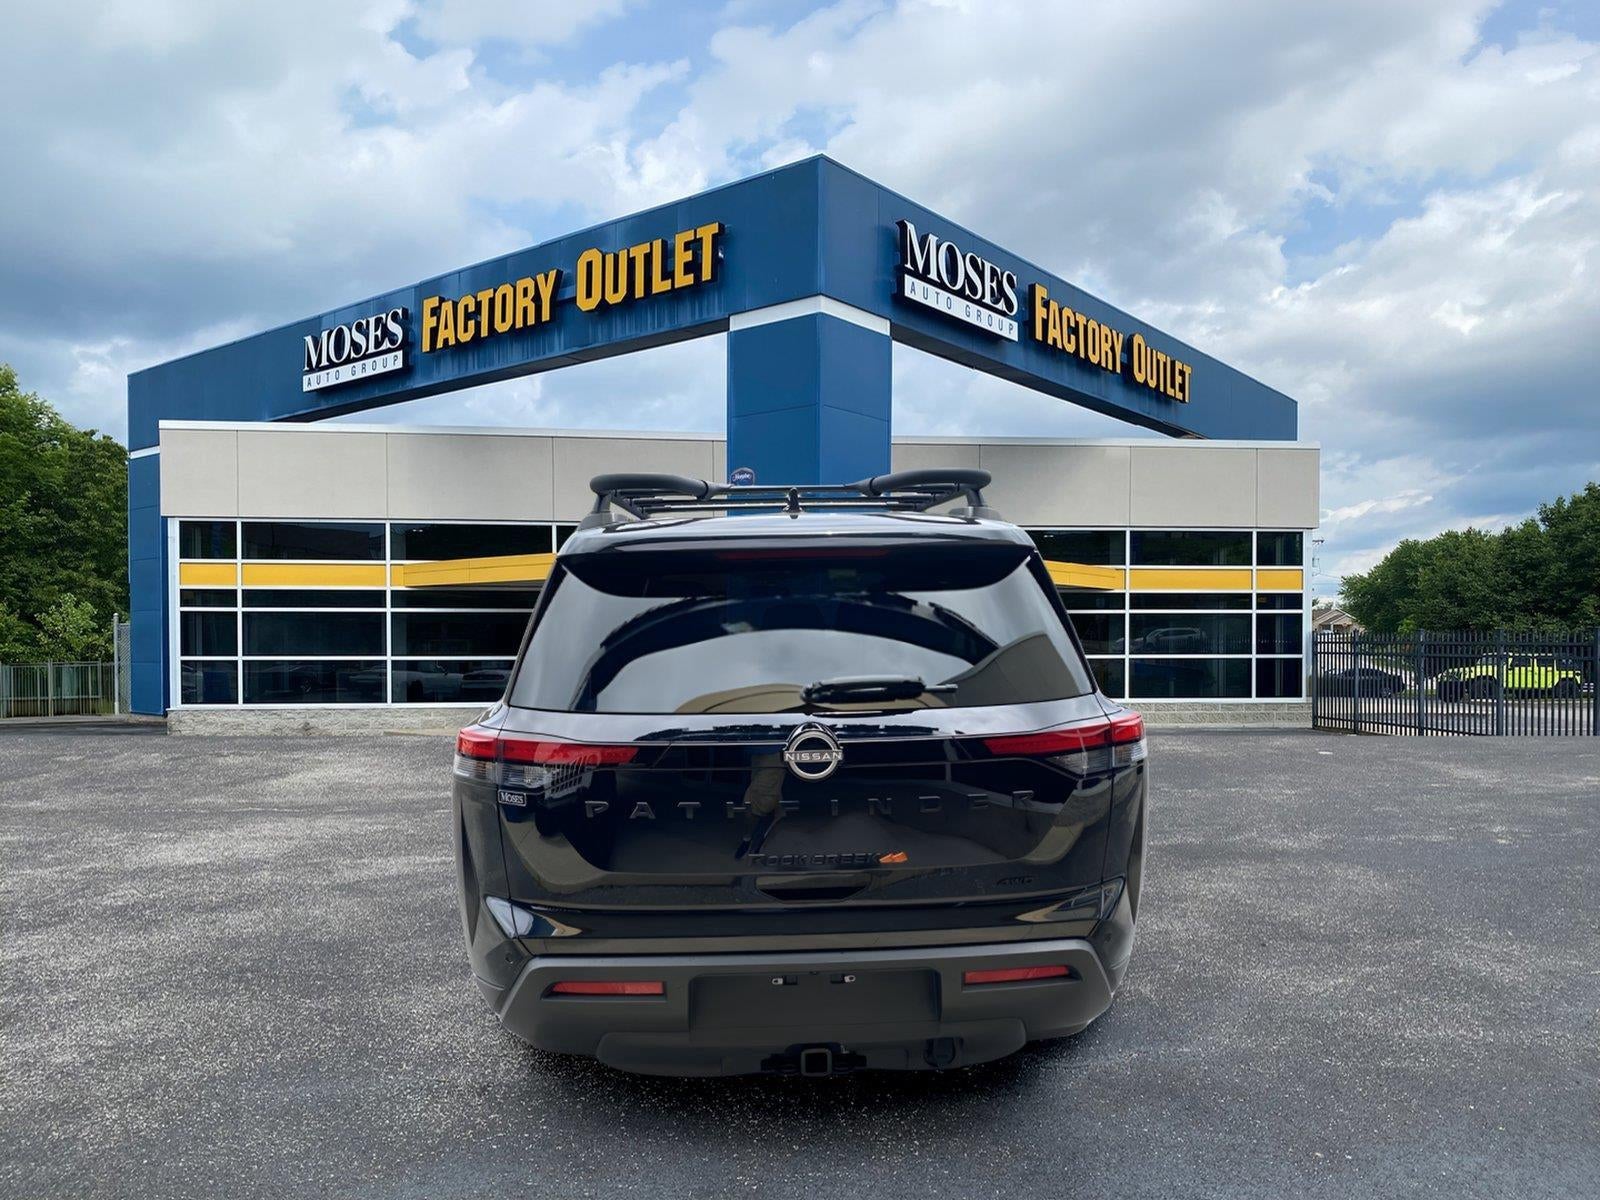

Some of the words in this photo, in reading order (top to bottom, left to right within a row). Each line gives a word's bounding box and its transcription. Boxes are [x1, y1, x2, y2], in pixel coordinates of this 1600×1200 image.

[421, 268, 561, 353] FACTORY
[576, 222, 721, 312] OUTLET
[904, 220, 1019, 316] MOSES
[909, 280, 953, 311] AUTO
[964, 304, 1016, 335] GROUP
[302, 307, 405, 371] MOSES
[1033, 282, 1124, 374] FACTORY
[1131, 332, 1193, 403] OUTLET
[306, 364, 341, 388] AUTO
[350, 353, 400, 377] GROUP
[785, 752, 843, 761] NISSAN
[500, 791, 524, 804] MOSES
[584, 789, 1036, 820] PATHFINDER
